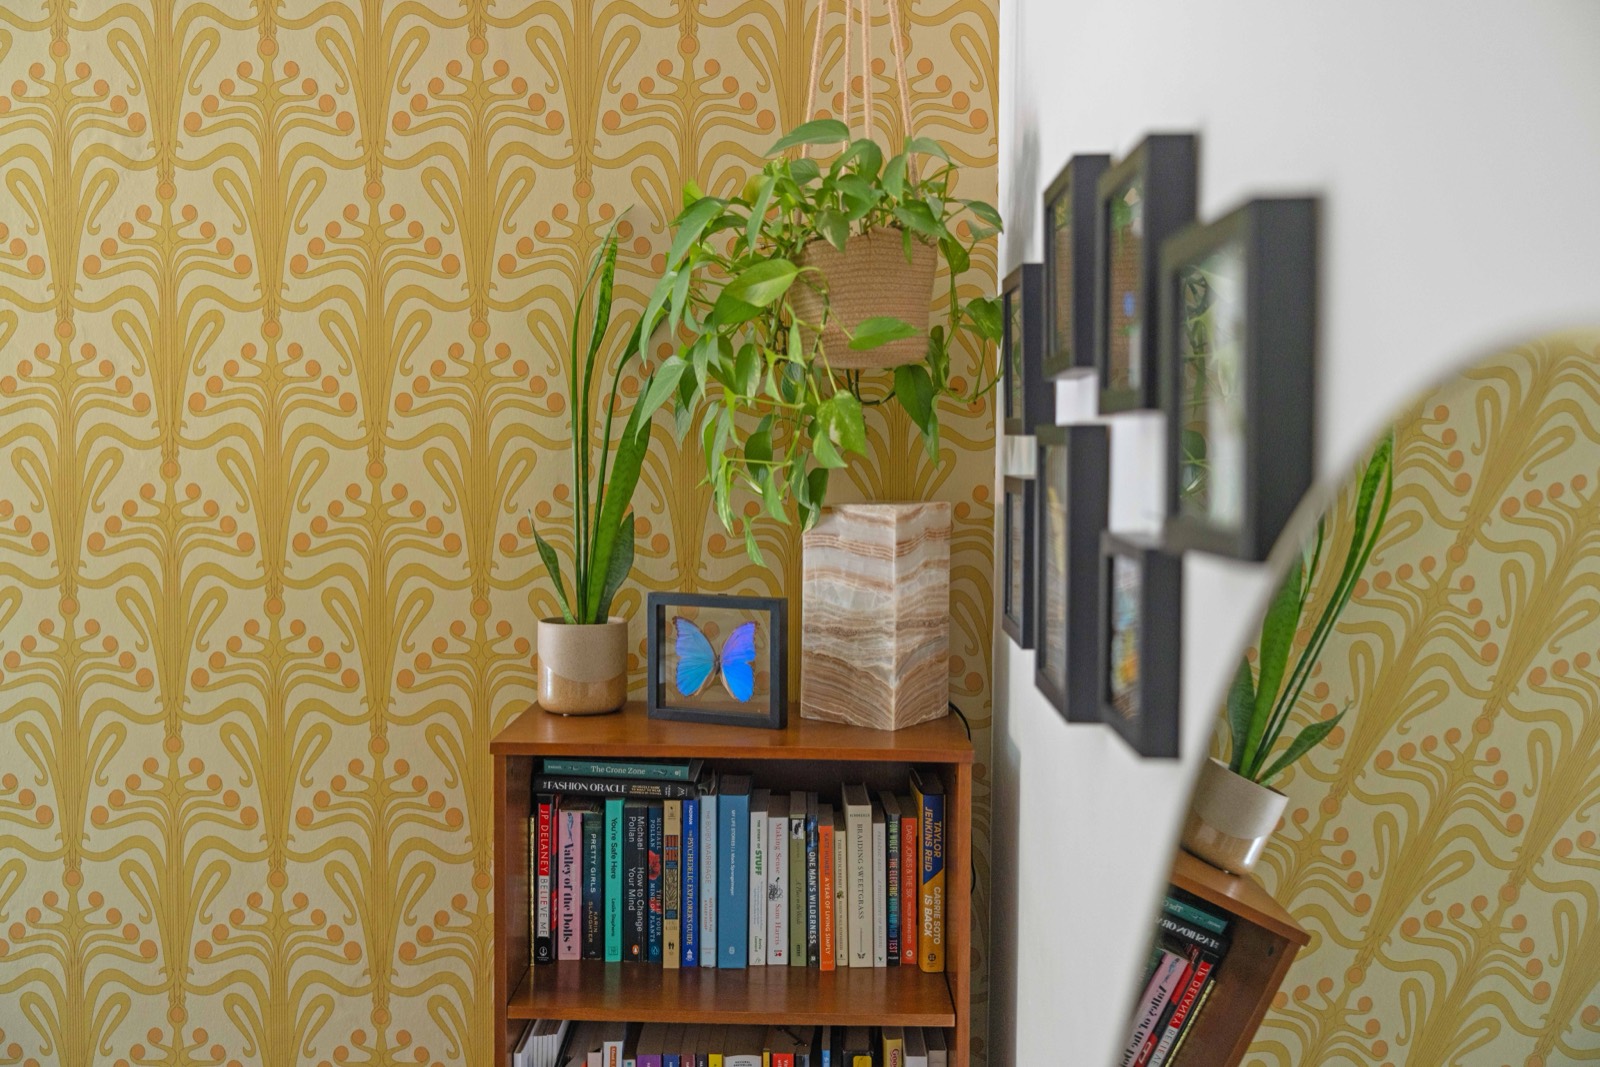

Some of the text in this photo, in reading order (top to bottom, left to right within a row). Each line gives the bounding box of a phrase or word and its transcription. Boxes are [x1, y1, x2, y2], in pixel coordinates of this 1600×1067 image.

[548, 781, 588, 790] FASHION
[590, 783, 627, 792] ORACLE
[606, 766, 626, 774] Crone
[540, 809, 548, 873] JP DELANEY
[628, 816, 636, 842] Pollan
[925, 807, 933, 872] JENKINS REID
[540, 879, 548, 934] BELIEVE ME
[562, 843, 573, 942] Valley of the Dolls
[628, 867, 636, 911] Your Mind
[637, 889, 644, 897] to
[825, 901, 830, 909] OF
[636, 900, 644, 931] Change
[924, 894, 932, 937] IS BACK
